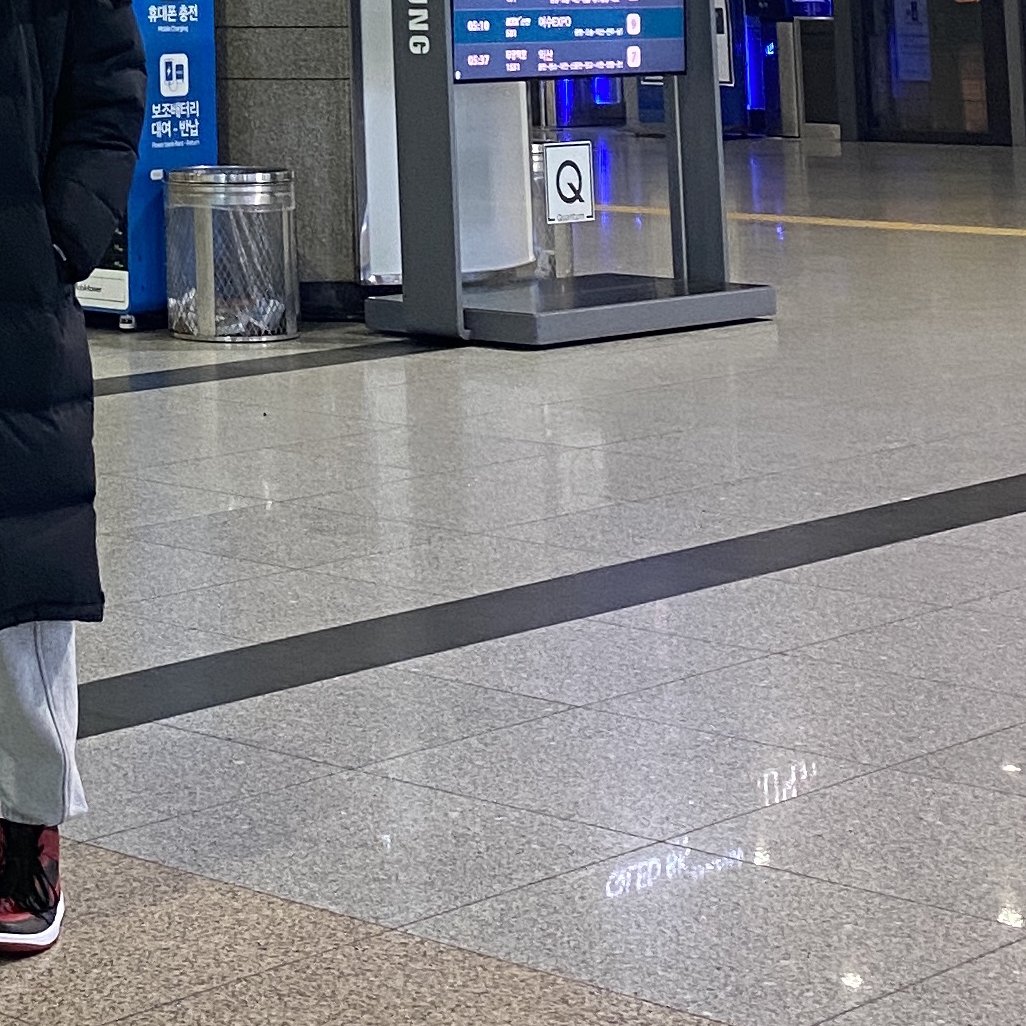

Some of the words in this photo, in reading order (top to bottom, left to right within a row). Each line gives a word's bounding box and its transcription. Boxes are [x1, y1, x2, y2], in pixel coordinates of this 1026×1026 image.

[148, 5, 177, 22] 휴대폰
[178, 4, 198, 22] 충전
[152, 101, 199, 118] 보조배터리
[152, 120, 171, 138] 대여
[179, 119, 199, 136] 반납
[556, 160, 585, 204] Q
